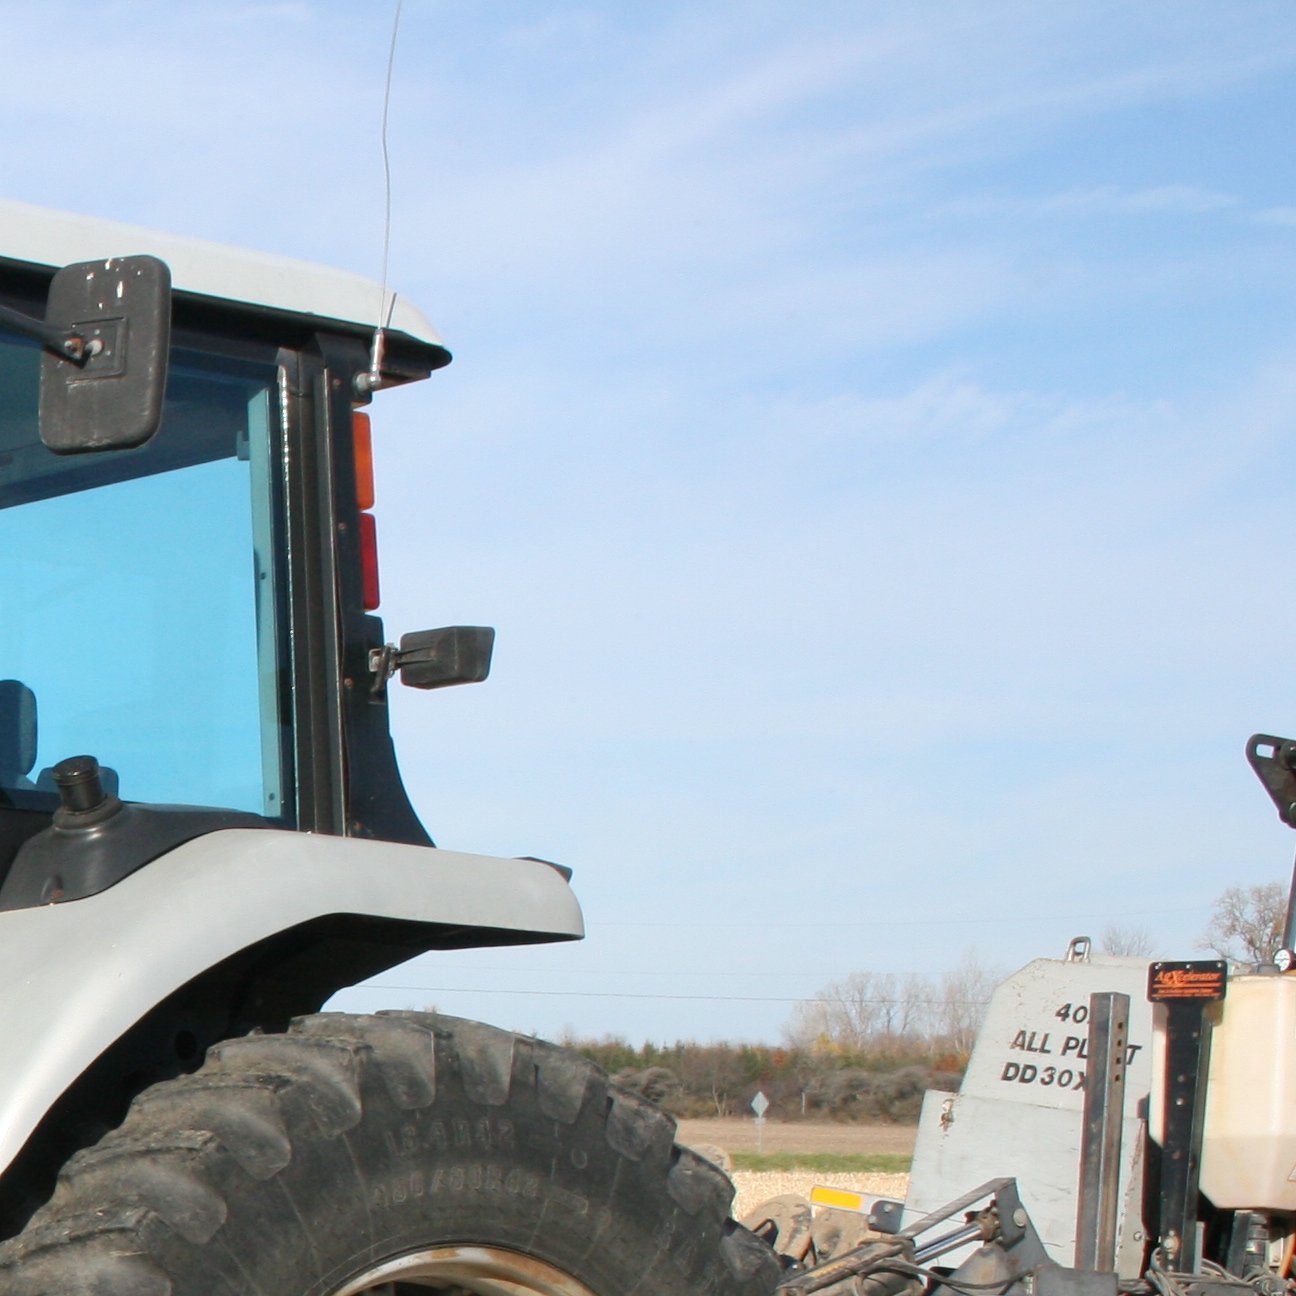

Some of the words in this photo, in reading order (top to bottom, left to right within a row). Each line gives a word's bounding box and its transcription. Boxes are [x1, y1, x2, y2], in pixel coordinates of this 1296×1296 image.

[1054, 1003, 1090, 1025] 40
[1010, 1030, 1051, 1054] ALL
[1060, 1036, 1143, 1066] PLT
